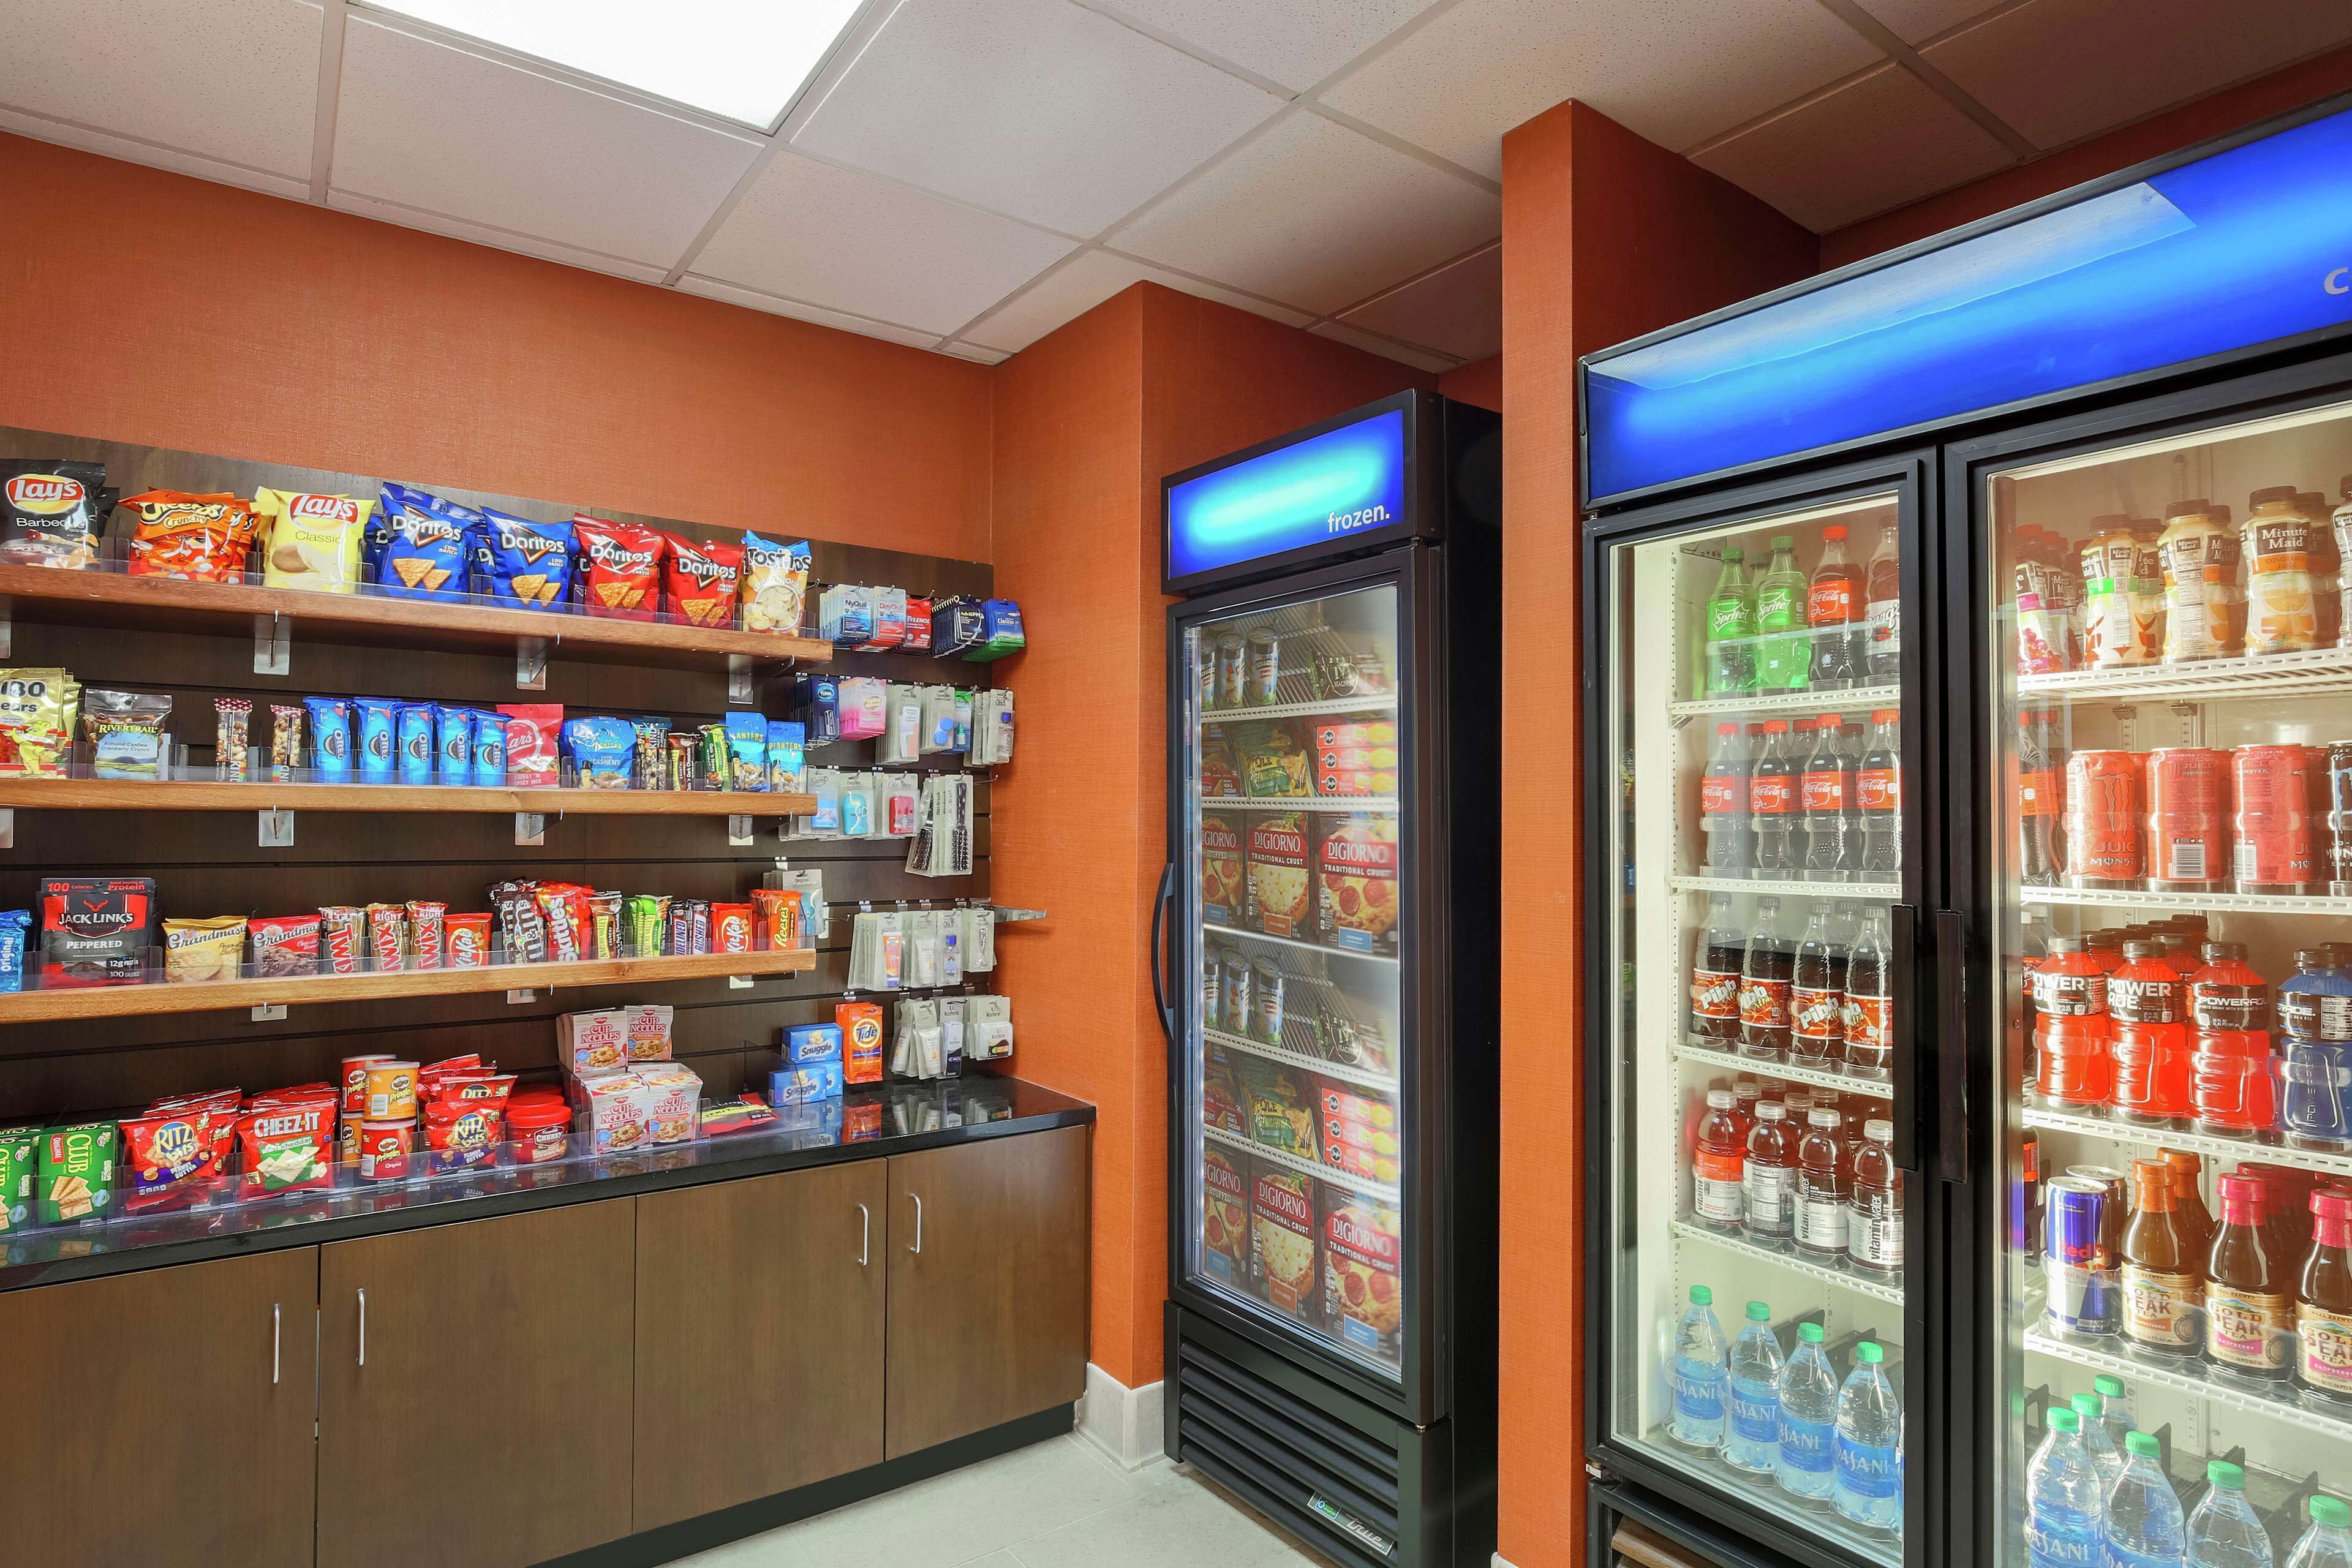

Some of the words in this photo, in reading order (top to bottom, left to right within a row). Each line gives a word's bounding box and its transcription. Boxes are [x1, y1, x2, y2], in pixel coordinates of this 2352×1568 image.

[14, 480, 78, 502] Lay's
[296, 494, 358, 519] Lay's
[164, 515, 206, 529] Crunchy
[1327, 504, 1390, 533] frozen.
[393, 516, 462, 541] Doritos
[2262, 527, 2308, 540] Minute
[295, 530, 344, 544] Classic
[502, 533, 565, 552] Doritos
[2268, 537, 2304, 549] Maid
[590, 545, 652, 563] Doritos
[679, 558, 736, 579] Doritos
[1811, 590, 1839, 602] Coca-Cola
[880, 603, 903, 611] DayQuil
[1758, 600, 1787, 616] Sprite
[1716, 609, 1746, 625] Sprite
[98, 724, 157, 734] RIVERTRAIL
[334, 729, 344, 760] OREO
[379, 730, 389, 761] OREO
[418, 733, 428, 763] OREO
[456, 734, 465, 764] OREO
[769, 742, 802, 750] PLANTERS
[492, 741, 500, 770] OREO
[1753, 785, 1782, 796] Coca-Cola
[1804, 782, 1833, 793] Coca-Cola
[1858, 778, 1888, 791] Coca-Cola
[1201, 832, 1237, 848] IGIORNO
[2095, 841, 2135, 854] JUIC
[1206, 850, 1228, 859] STUFFED
[1252, 853, 1285, 864] TRADITIONAL
[1286, 857, 1303, 865] CRUST
[2090, 856, 2136, 867] MONST
[1324, 864, 1365, 876] TRADITIONAL
[48, 882, 70, 892] 100
[59, 913, 92, 925] JACK
[93, 912, 134, 924] LINK'S
[375, 913, 402, 922] RIGHT
[419, 909, 443, 919] RIGHT
[551, 897, 578, 961] Skittles
[774, 906, 790, 948] Reese's
[167, 925, 241, 950] Grandma's
[252, 924, 320, 949] Grandma's
[675, 921, 686, 955] IDELINED
[694, 920, 705, 952] RUSHED
[66, 940, 123, 949] PEPPERED
[372, 924, 403, 971] TWIX
[414, 921, 442, 969] TWIX
[1, 937, 14, 971] original
[1700, 978, 1736, 1010] Pibb
[2108, 978, 2171, 997] POWER
[638, 1016, 660, 1025] CUP
[1799, 997, 1839, 1030] Pibb
[590, 1025, 612, 1035] CUP
[630, 1023, 667, 1033] NOODLES
[856, 1026, 878, 1042] Tide
[581, 1031, 620, 1044] NOODLES
[801, 1043, 832, 1057] Snuggle
[390, 1087, 412, 1103] Pringles
[786, 1084, 816, 1099] Snuggle
[610, 1102, 635, 1114] CUP
[653, 1102, 691, 1115] NOODLES
[663, 1096, 686, 1106] CUP
[600, 1109, 643, 1125] NOODLES
[453, 1114, 486, 1139] RITZ
[154, 1124, 195, 1153] RITZ
[461, 1133, 485, 1147] bits
[536, 1131, 563, 1143] CHUNKY
[54, 1136, 62, 1159] ORIGINAL
[67, 1134, 92, 1174] CLUB
[166, 1144, 195, 1161] bits
[464, 1148, 481, 1159] PEANUT
[376, 1149, 401, 1164] Pringles
[466, 1152, 484, 1164] BUTTER
[171, 1162, 192, 1173] PEANUT
[175, 1164, 197, 1179] BUTTER
[1204, 1163, 1240, 1193] IGIORNO
[1209, 1186, 1232, 1203] STUFFED
[1256, 1205, 1291, 1228] TRADITIONAL
[1292, 1222, 1309, 1235] CRUST
[1329, 1241, 1370, 1264] TRADITIONAL
[2134, 1288, 2172, 1300] OLD
[2136, 1309, 2158, 1319] TEA
[2224, 1330, 2247, 1340] TEA
[2218, 1336, 2255, 1351] RASPBERRY
[2320, 1354, 2346, 1366] TEA
[1676, 1379, 1715, 1400] ASANI
[2026, 1528, 2089, 1561] ASANI
